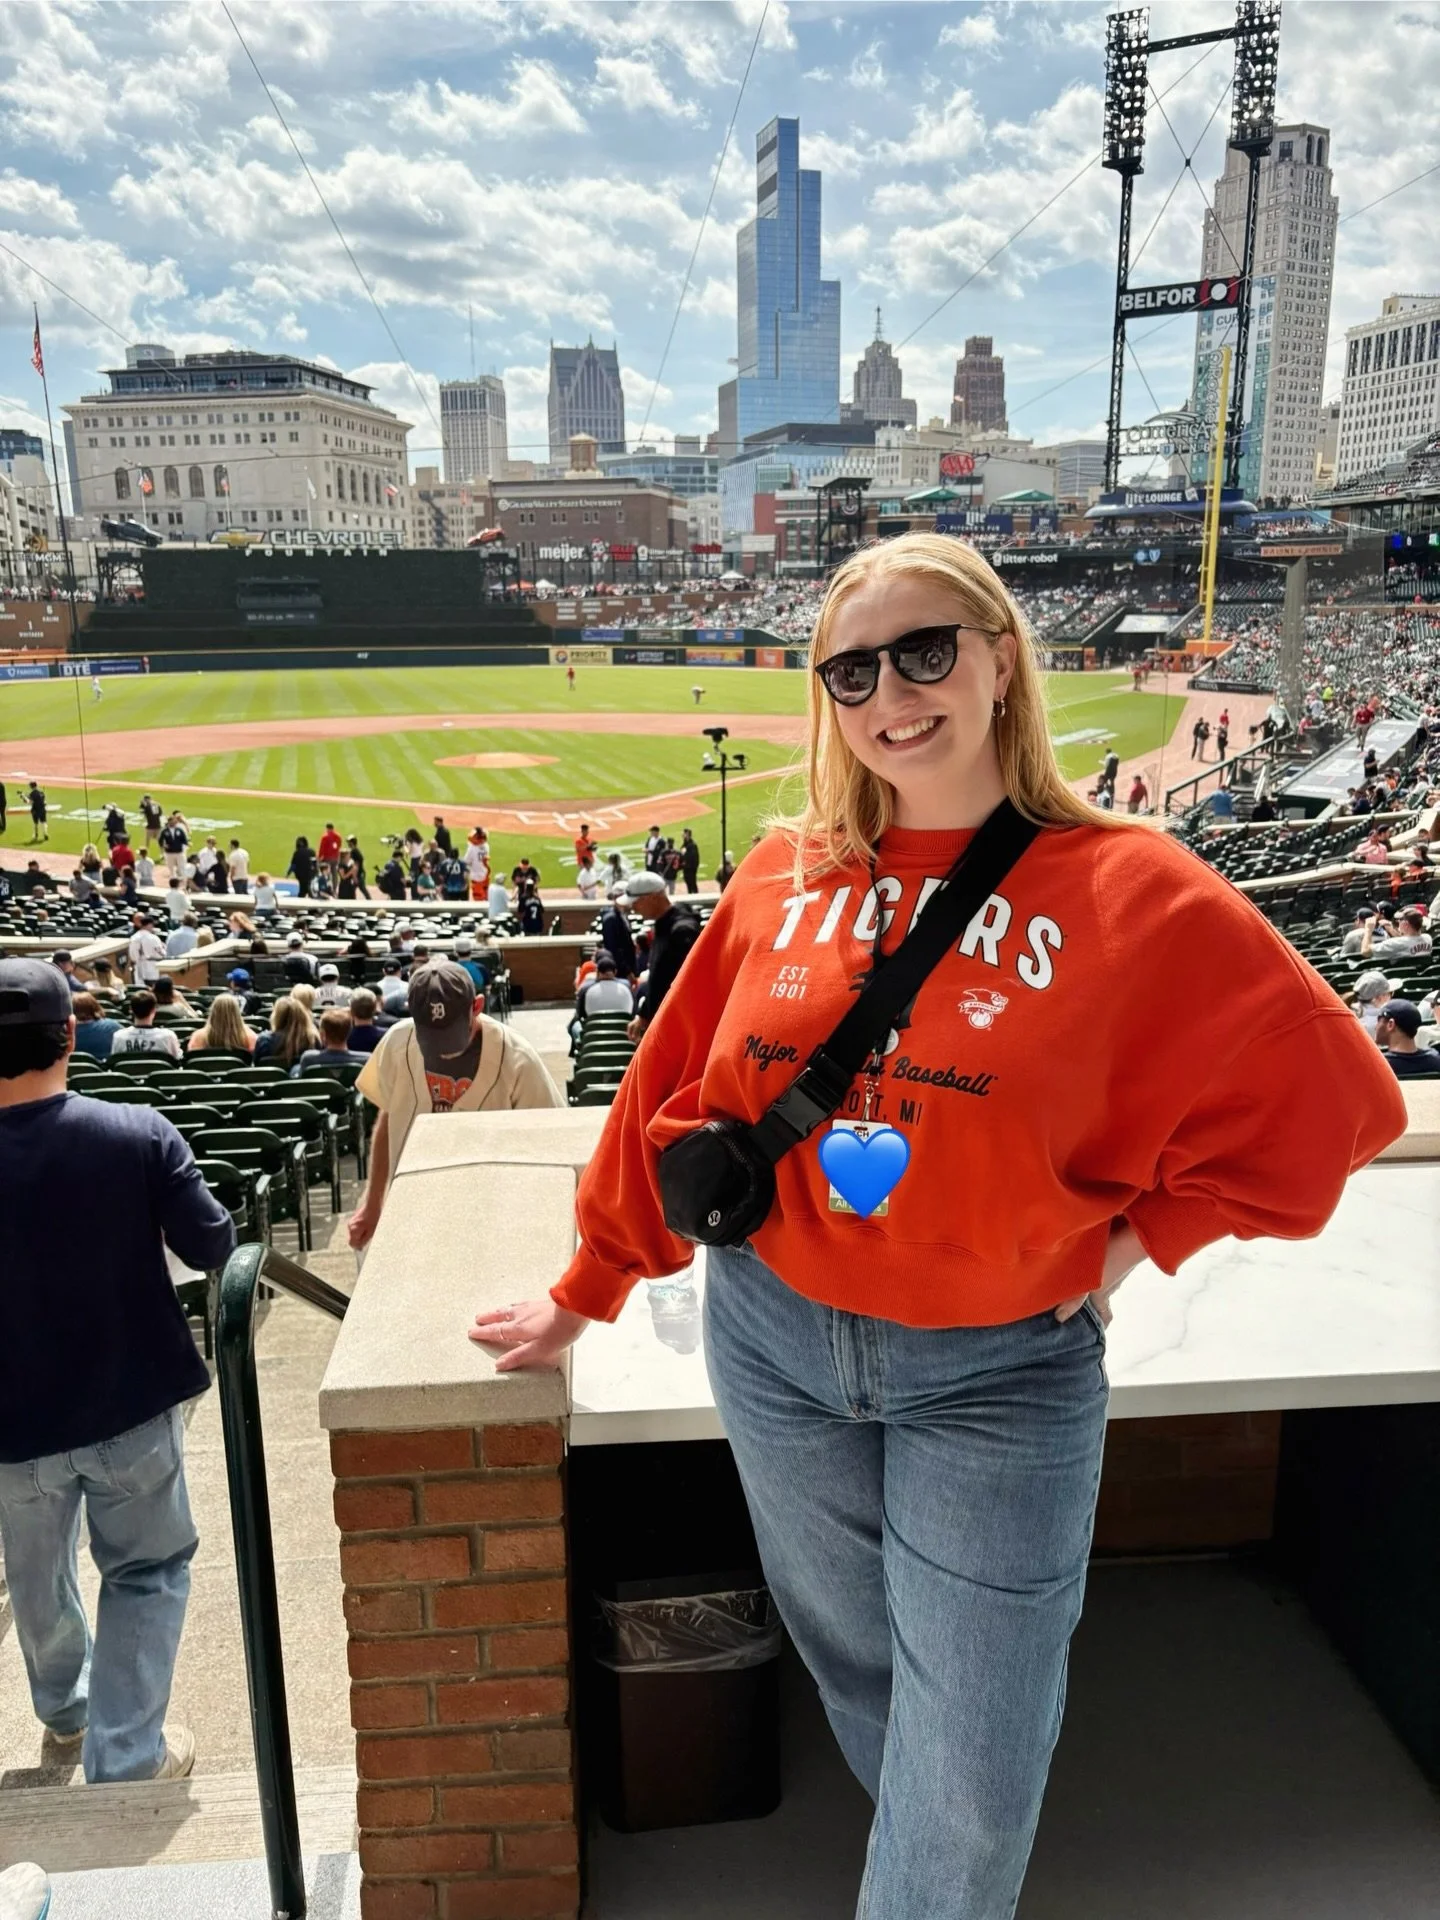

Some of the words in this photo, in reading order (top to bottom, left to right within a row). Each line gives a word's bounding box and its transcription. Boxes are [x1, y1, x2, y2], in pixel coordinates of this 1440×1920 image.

[1120, 287, 1196, 311] BELFOR
[942, 454, 974, 475] AAA
[1145, 492, 1182, 502] LOUNGE
[270, 530, 406, 545] CHEVROLET
[245, 548, 388, 557] FOUNTAIN
[539, 543, 585, 562] meijer
[63, 663, 91, 676] DTE
[778, 965, 809, 981] EST.
[769, 982, 807, 1000] 1901
[430, 1002, 446, 1022] D
[744, 1034, 799, 1072] Major
[891, 1055, 994, 1097] Baseball
[900, 1100, 922, 1126] MI
